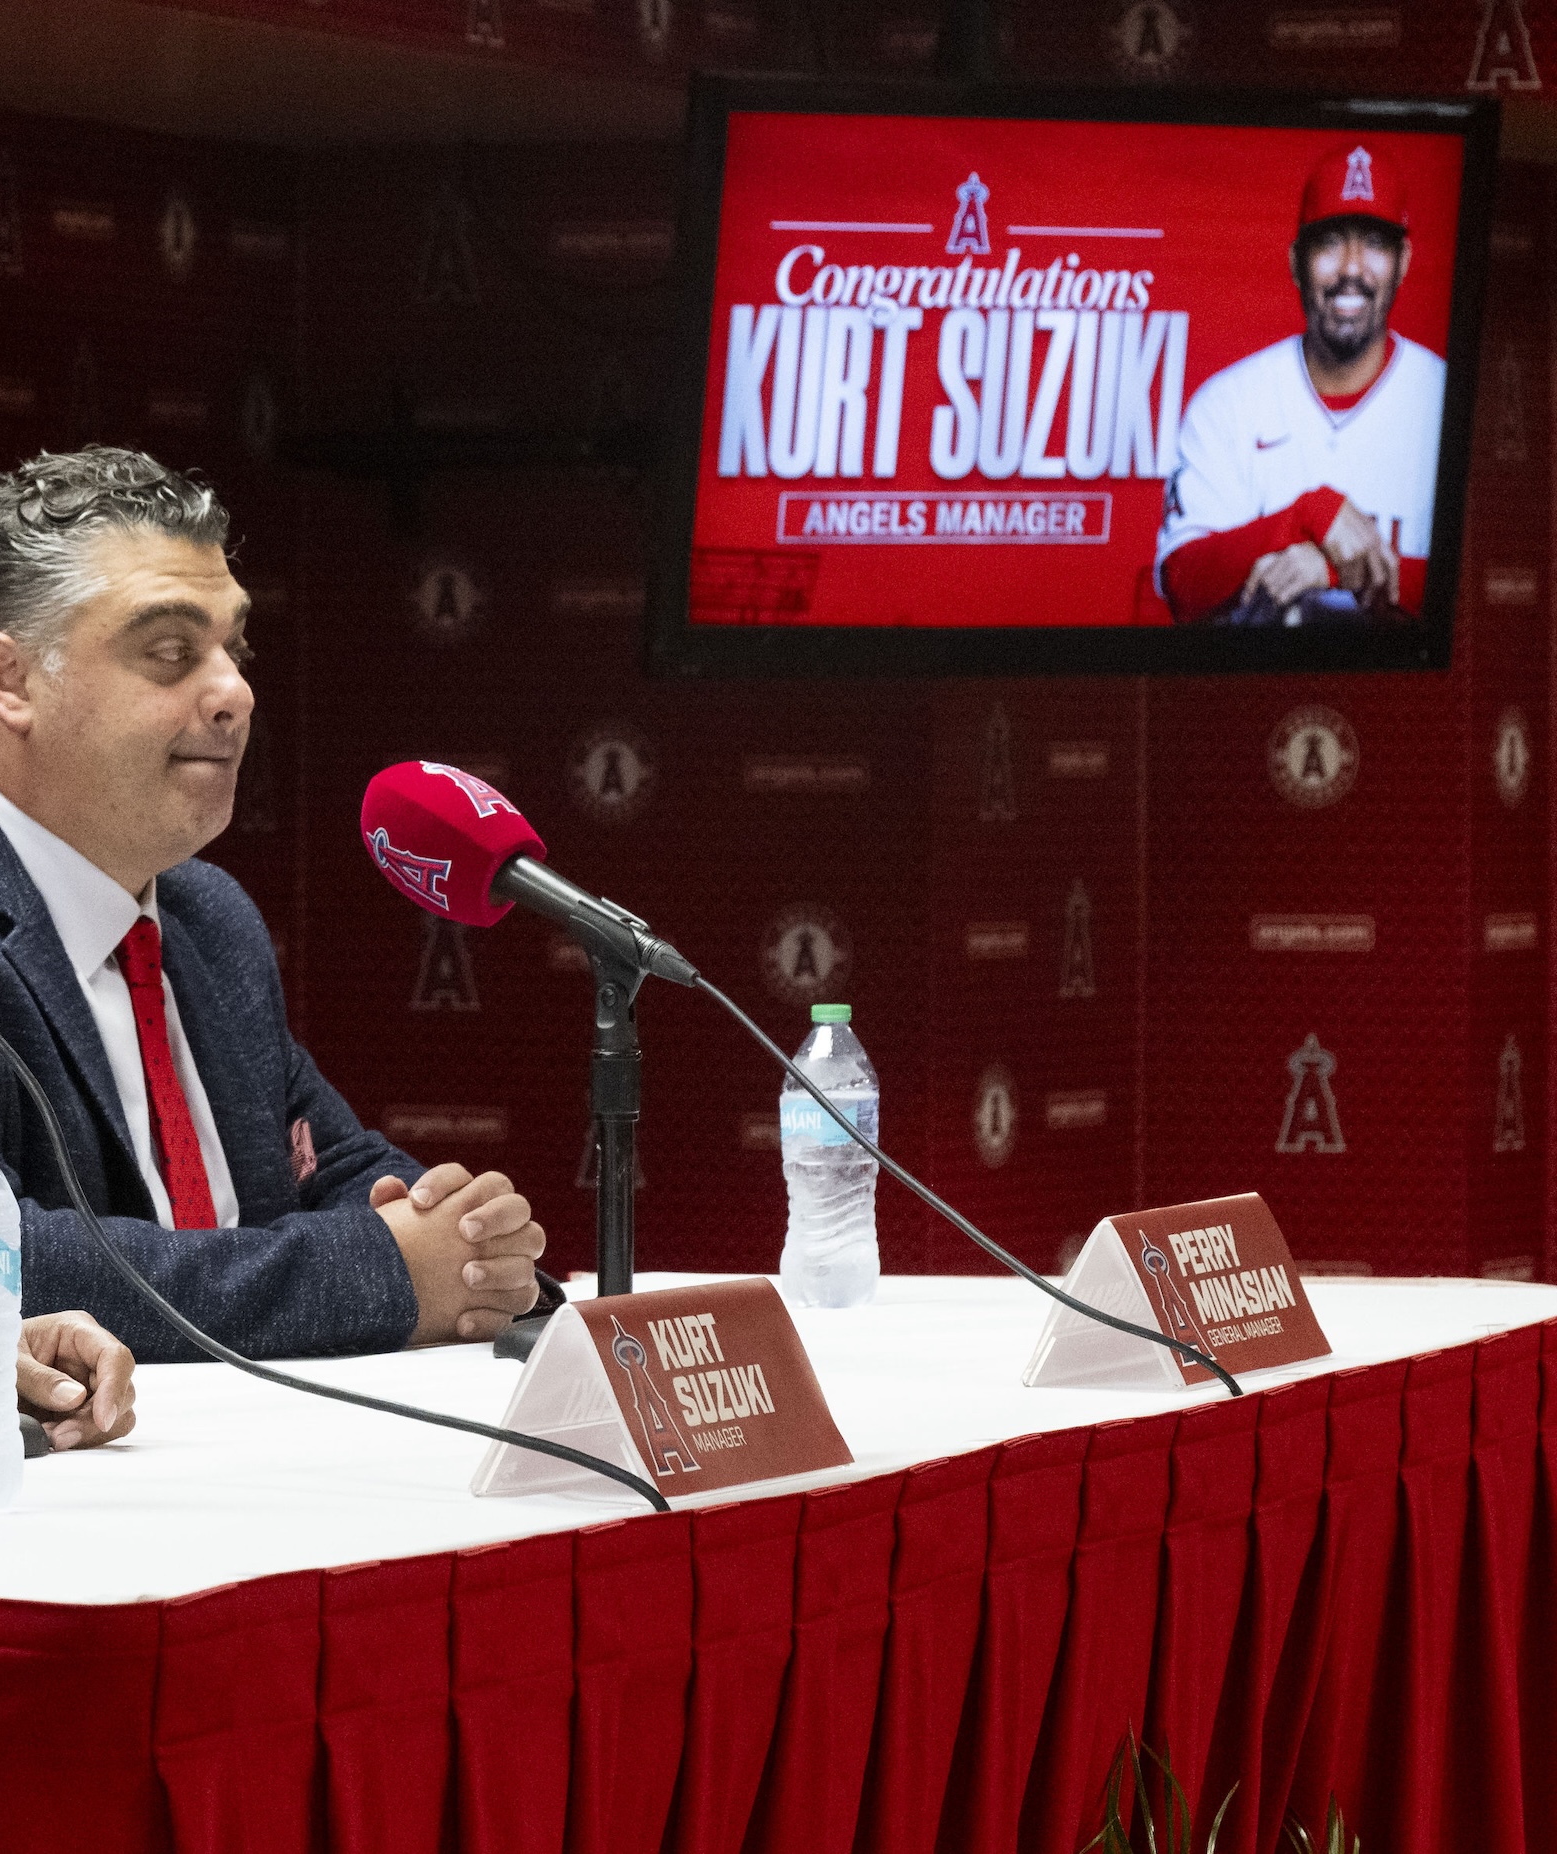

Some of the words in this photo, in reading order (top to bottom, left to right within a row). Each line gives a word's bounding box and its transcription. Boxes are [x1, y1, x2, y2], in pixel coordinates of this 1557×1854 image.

[945, 171, 992, 255] A
[775, 244, 1155, 325] Congratulations
[717, 302, 924, 480] KURT
[929, 306, 1190, 482] SUZUKI
[802, 499, 928, 538] ANGELS
[935, 500, 1088, 539] MANAGER
[419, 759, 522, 819] A
[365, 826, 453, 912] A
[781, 1105, 822, 1135] ASANI
[1167, 1223, 1241, 1278] PERRY
[1138, 1229, 1218, 1368] A
[1188, 1264, 1297, 1326] MINASIAN
[647, 1312, 725, 1371] KURT
[1207, 1325, 1248, 1348] GENERAL
[1242, 1315, 1285, 1340] MANAGER
[610, 1314, 702, 1477] A
[673, 1363, 776, 1427] SUZUKI
[691, 1425, 748, 1455] MANAGER
